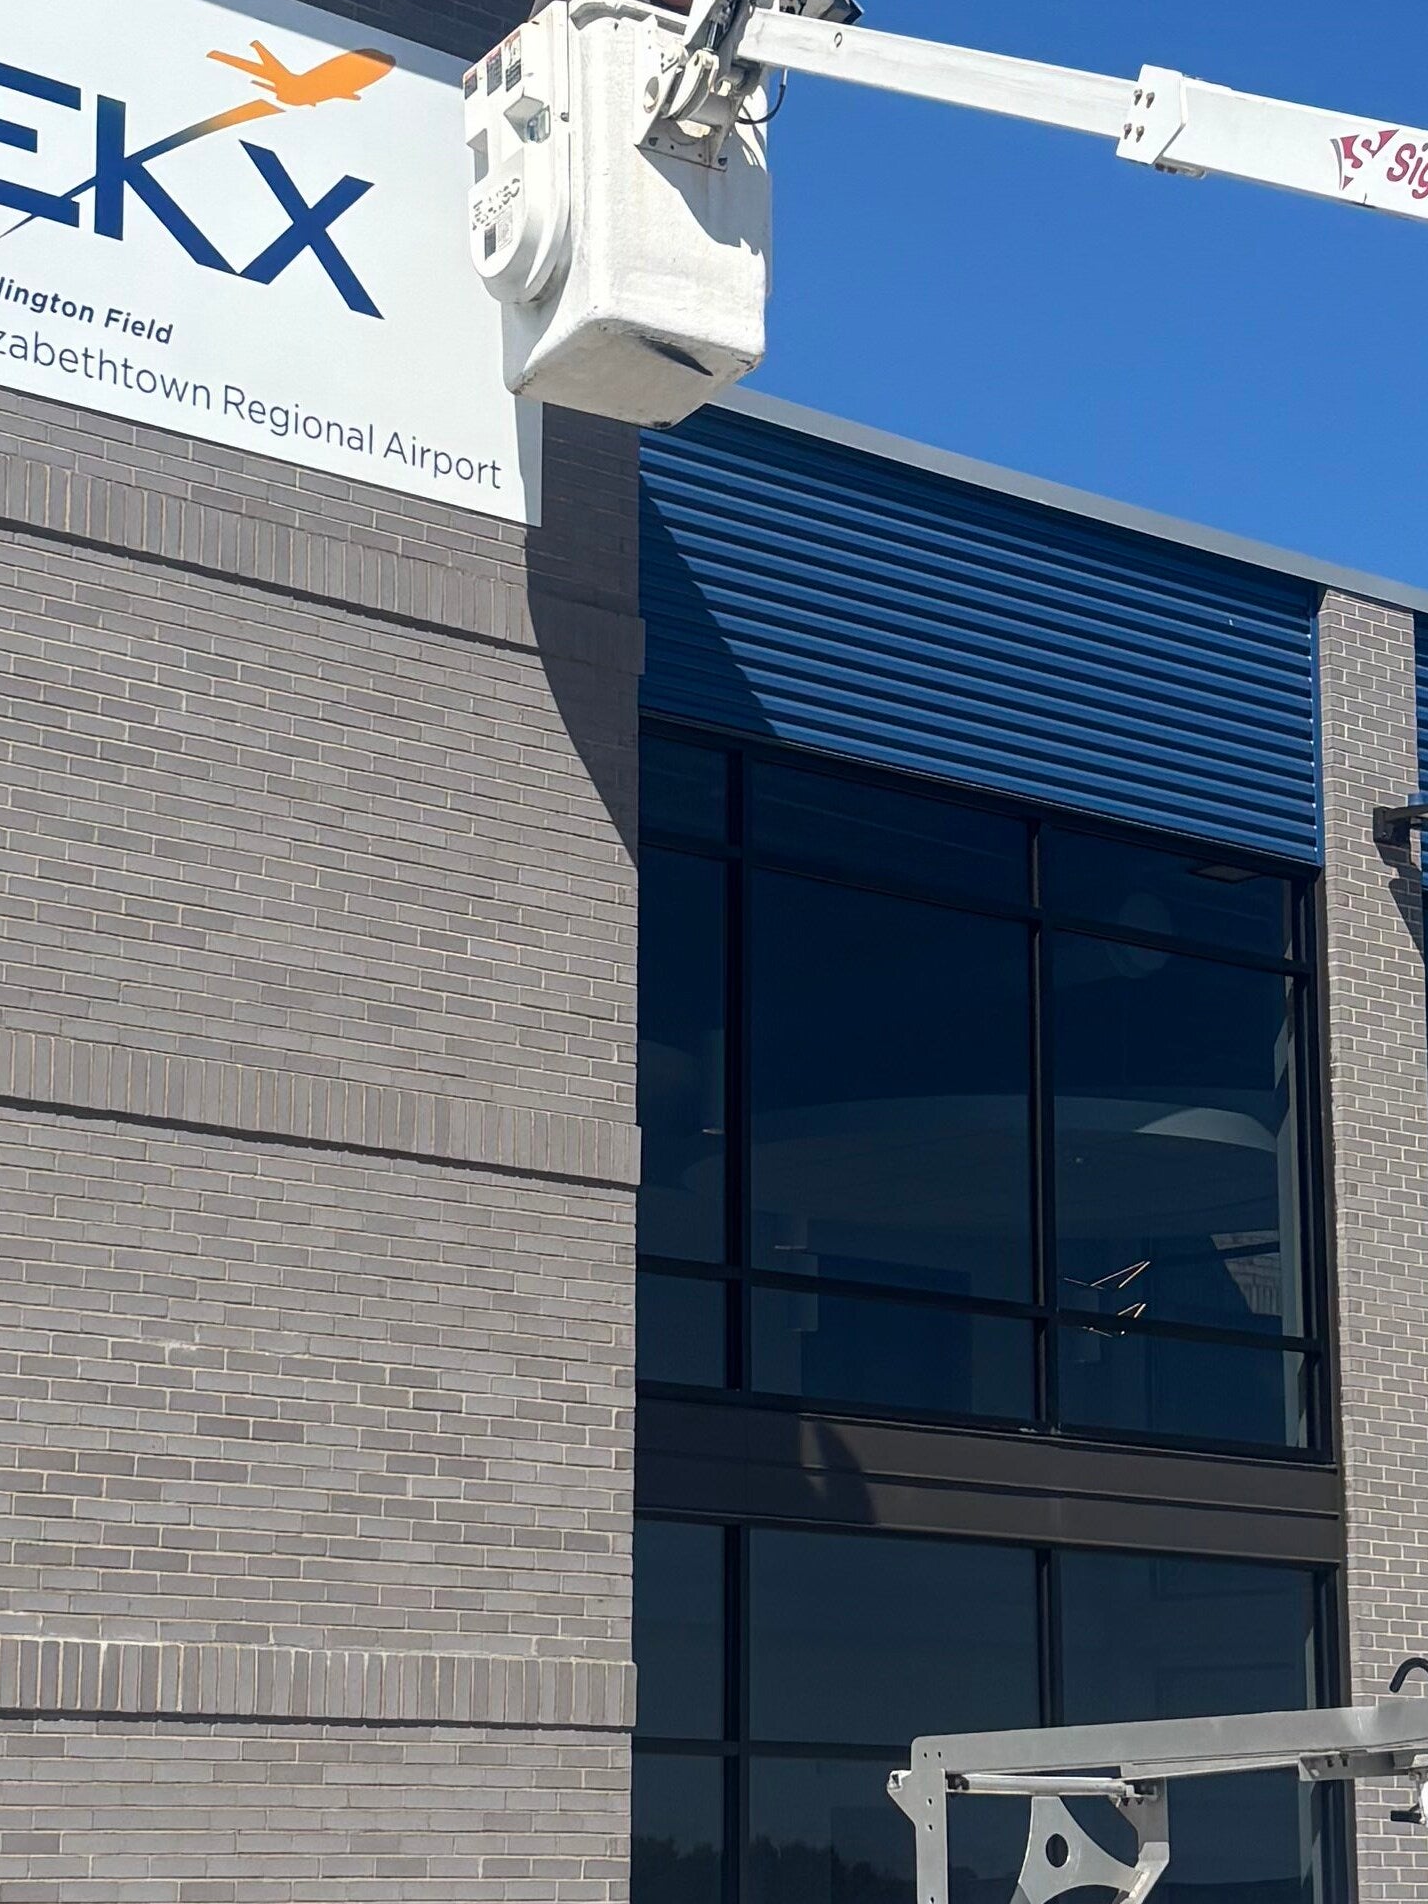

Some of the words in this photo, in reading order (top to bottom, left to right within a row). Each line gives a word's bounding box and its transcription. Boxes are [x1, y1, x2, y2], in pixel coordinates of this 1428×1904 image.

[104, 308, 174, 345] Field
[223, 384, 373, 455] Regional
[383, 431, 502, 490] Airport
